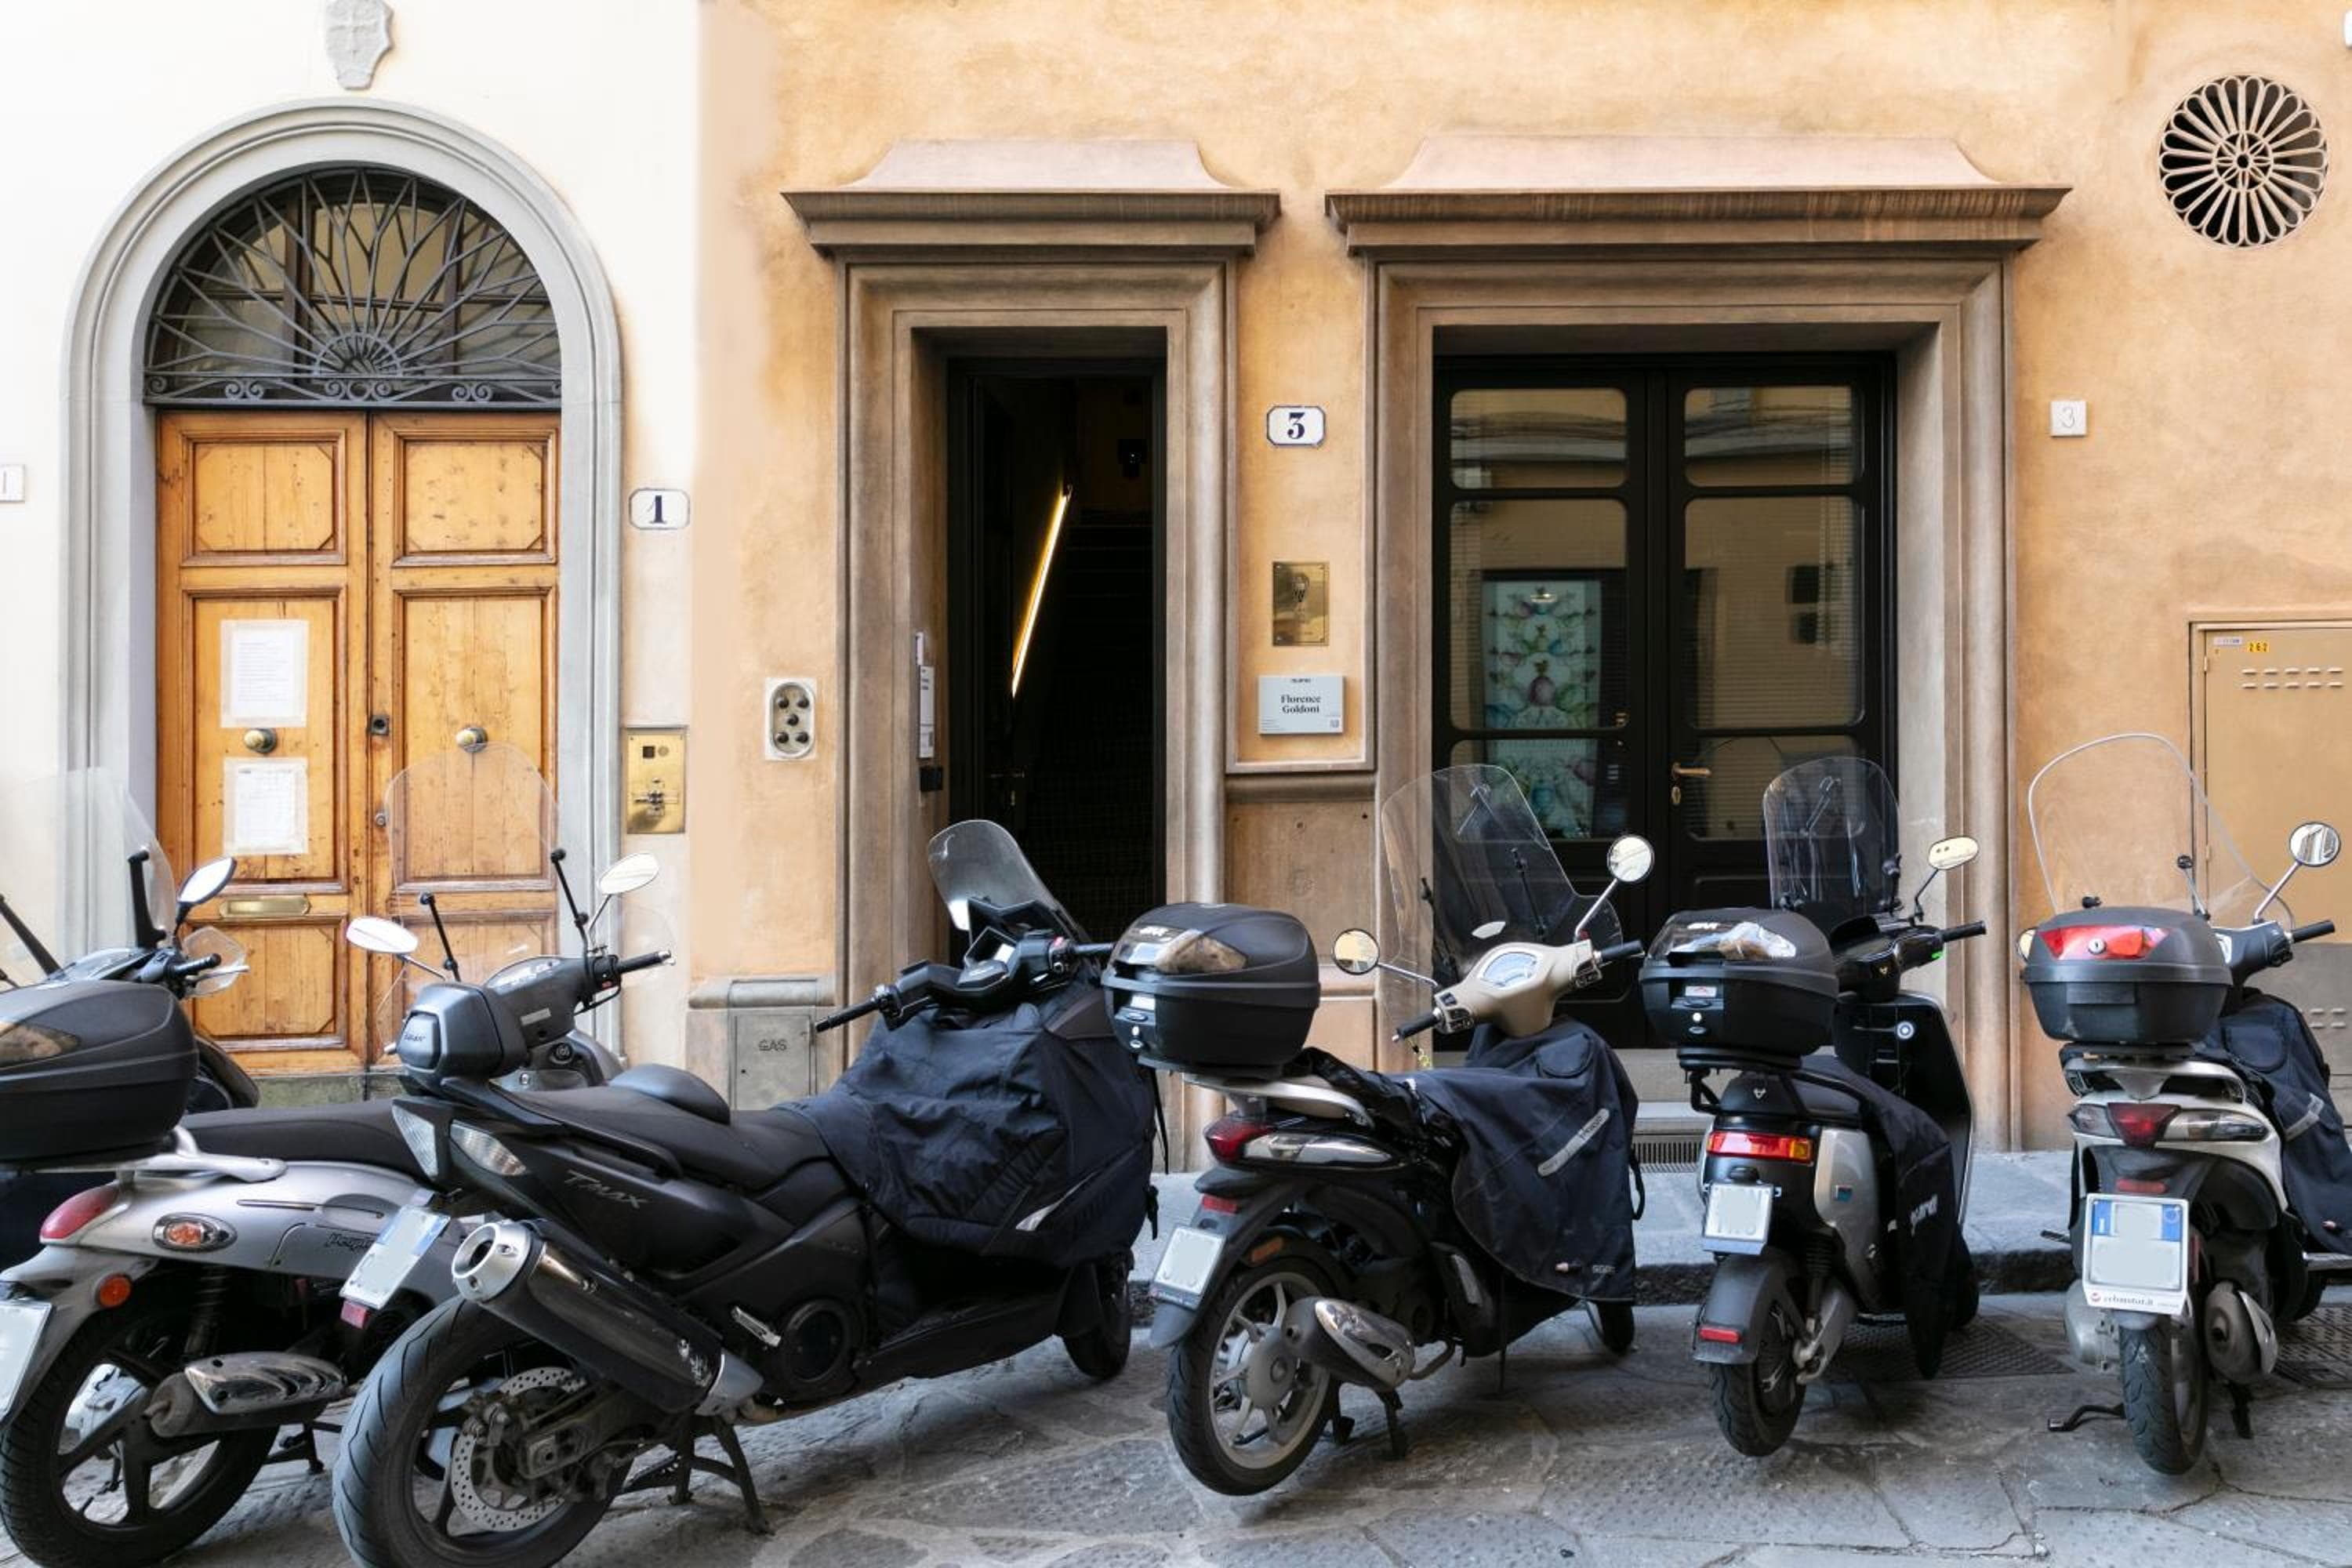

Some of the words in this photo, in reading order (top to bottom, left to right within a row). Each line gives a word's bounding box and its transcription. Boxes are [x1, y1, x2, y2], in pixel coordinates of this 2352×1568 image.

[1287, 412, 1305, 440] 3
[647, 495, 668, 524] 1
[1280, 694, 1321, 703] Florence
[1282, 705, 1319, 714] Goldoni
[758, 1039, 787, 1051] GAS
